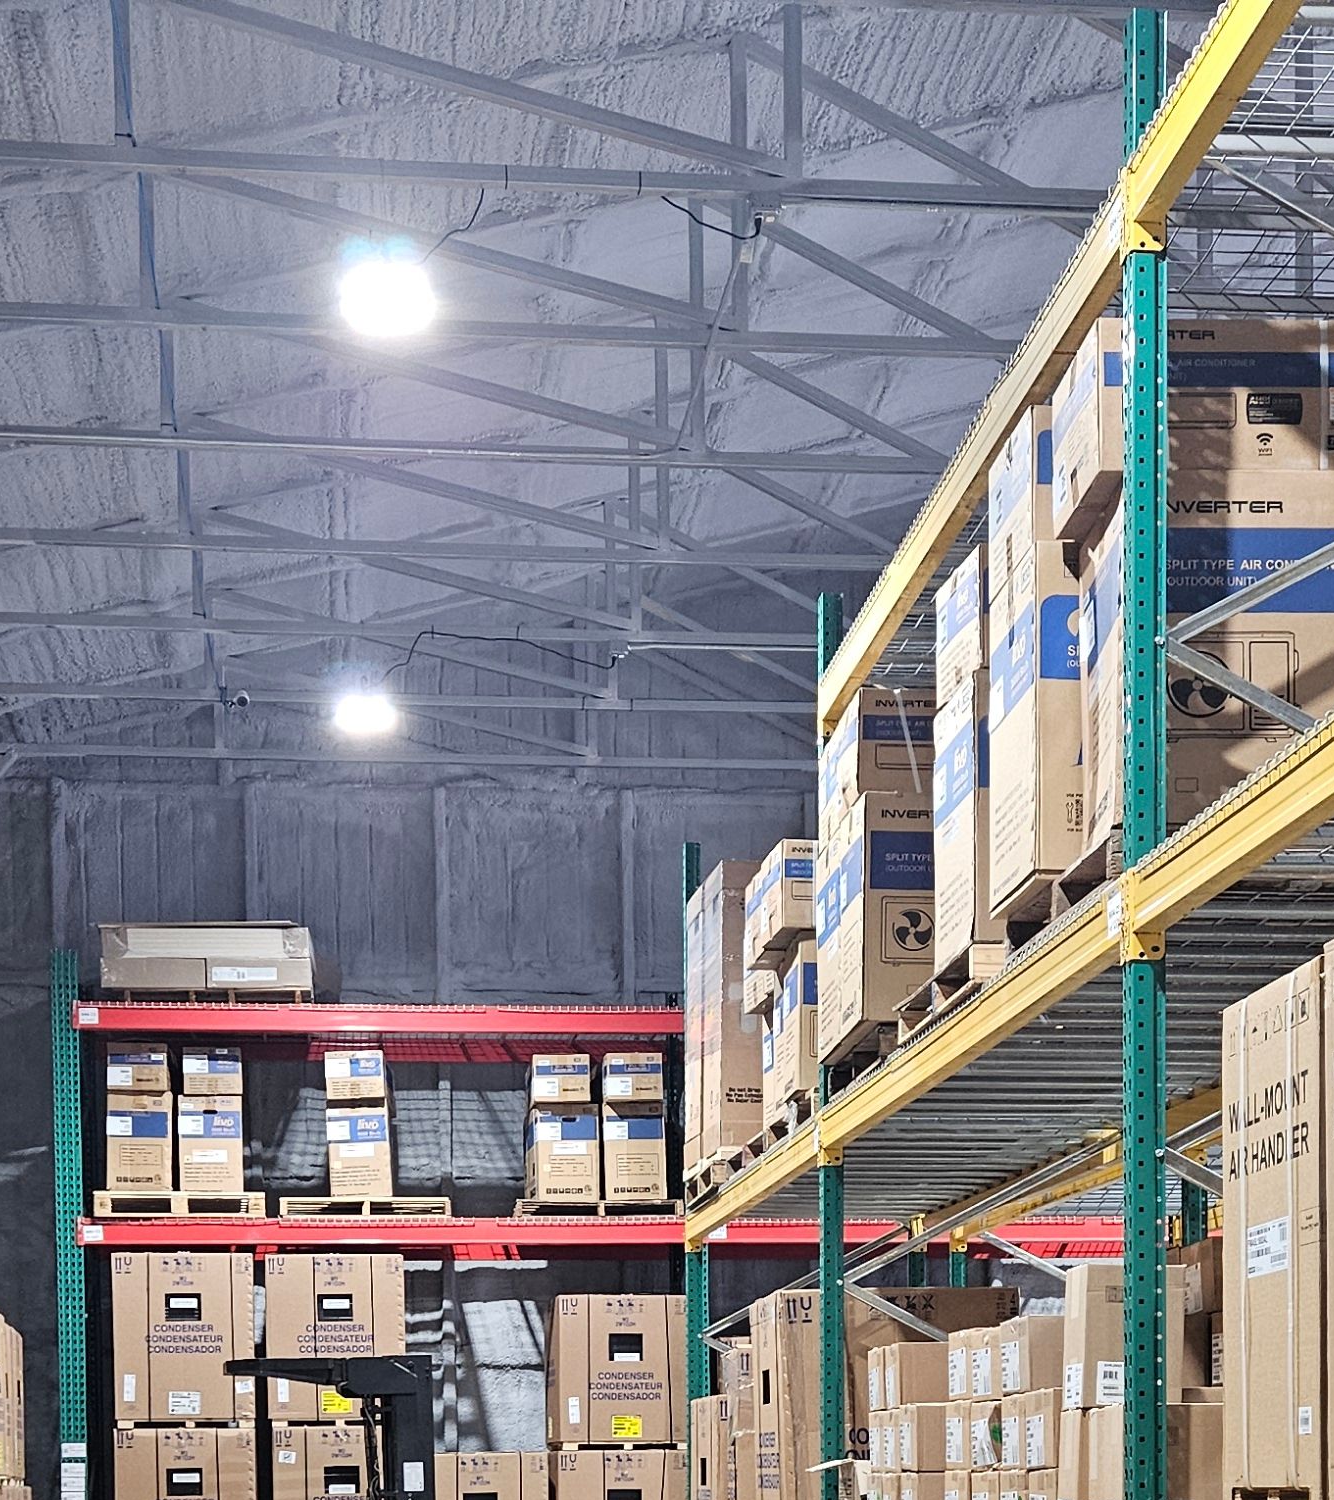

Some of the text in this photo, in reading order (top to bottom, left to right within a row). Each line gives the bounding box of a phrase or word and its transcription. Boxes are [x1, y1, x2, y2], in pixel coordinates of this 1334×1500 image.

[1167, 500, 1284, 514] NVERTER
[1166, 559, 1263, 571] SPLIT TYPE AIR
[1228, 1069, 1309, 1134] WALL-MOUNT
[1228, 1121, 1310, 1182] AIR HANDLER
[153, 1324, 214, 1333] CONDENSER
[305, 1324, 365, 1333] CONDENSER
[145, 1334, 223, 1343] CONDENSATEUR
[297, 1334, 375, 1343] CONDENSATEUR
[147, 1345, 222, 1354] CONDENSADOR
[299, 1344, 373, 1353] CONDENSADOR
[598, 1372, 654, 1380] CONDENSER
[589, 1382, 663, 1390] CONDENSATEUR
[591, 1392, 662, 1400] CONDENSADOR
